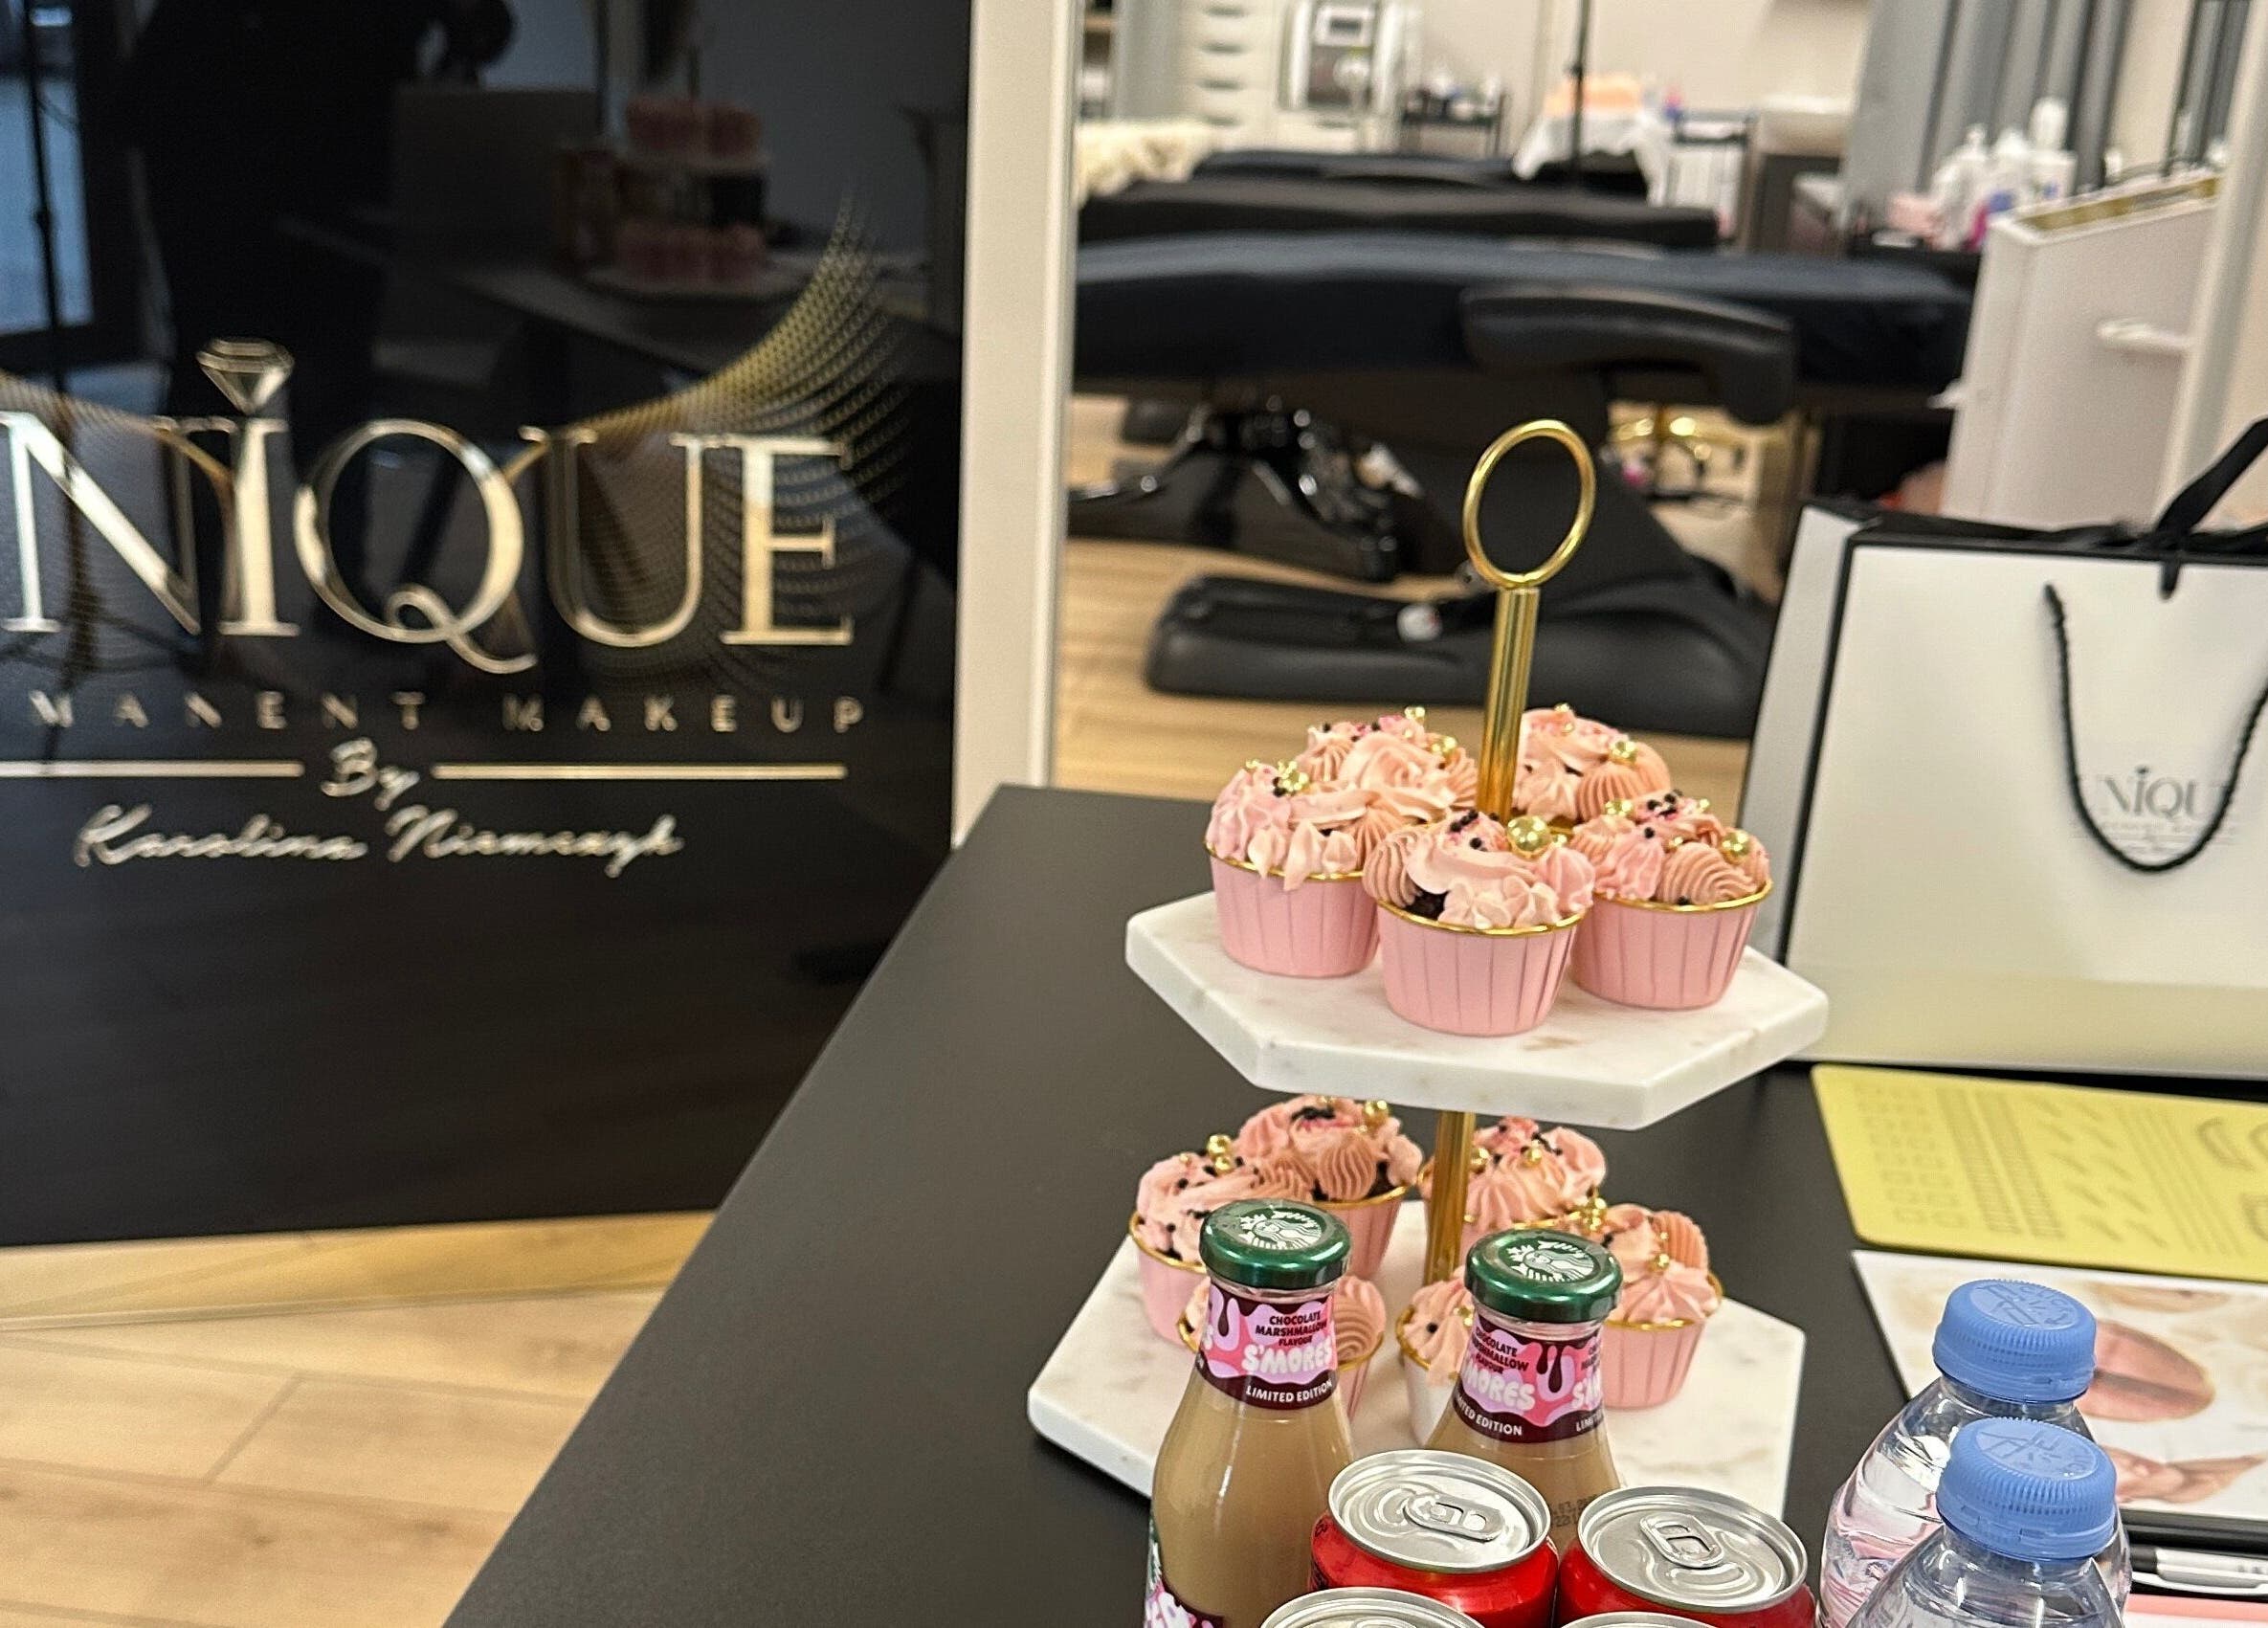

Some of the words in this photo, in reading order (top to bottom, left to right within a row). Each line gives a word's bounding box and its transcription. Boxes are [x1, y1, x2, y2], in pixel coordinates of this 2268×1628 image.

[501, 691, 862, 733] MAKEUP
[321, 737, 420, 812] By
[74, 804, 368, 866] Karolina
[1256, 1320, 1327, 1336] MARSHMALLOW
[1270, 1311, 1321, 1325] CHOCOLATE
[1242, 1335, 1333, 1374] S'MORES
[1246, 1386, 1294, 1403] LIMITED
[1297, 1378, 1333, 1402] EDITION
[1476, 1414, 1523, 1436] EDITION
